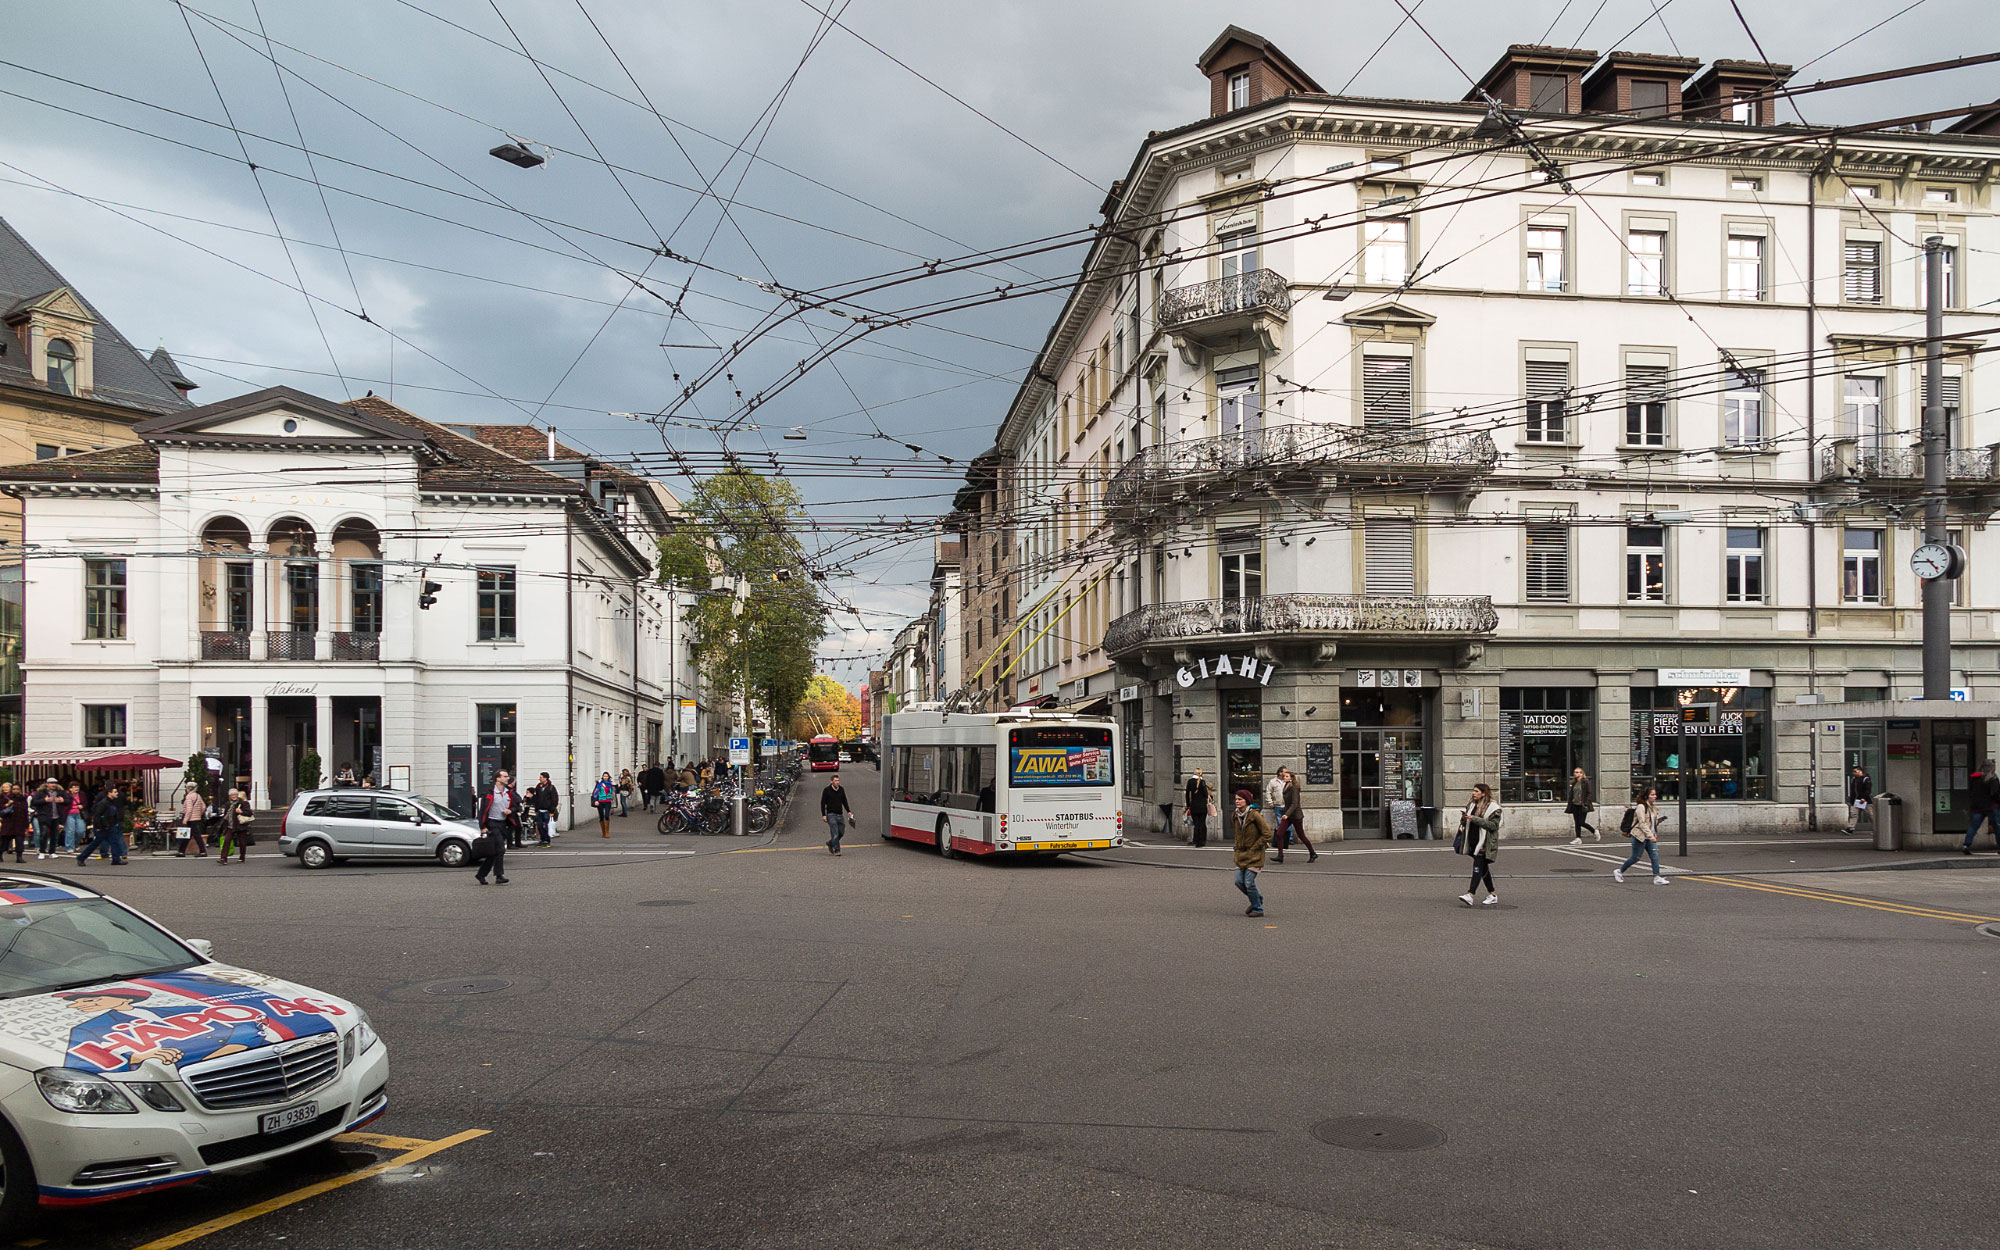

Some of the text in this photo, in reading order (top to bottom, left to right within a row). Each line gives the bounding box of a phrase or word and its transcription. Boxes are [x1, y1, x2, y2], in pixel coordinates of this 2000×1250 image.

[1176, 654, 1275, 688] GIAHI
[263, 681, 318, 696] National
[1523, 715, 1567, 724] TATTOOS
[1910, 730, 1919, 743] A
[732, 739, 740, 749] P
[1015, 748, 1068, 773] TAWA
[1068, 753, 1082, 761] guter
[1069, 759, 1081, 767] gute
[1012, 814, 1025, 823] 101
[1055, 812, 1094, 821] STADTBUS
[1046, 822, 1079, 830] Winterthur
[69, 997, 347, 1070] HÄPO AG
[267, 1105, 316, 1130] ZH 93839
